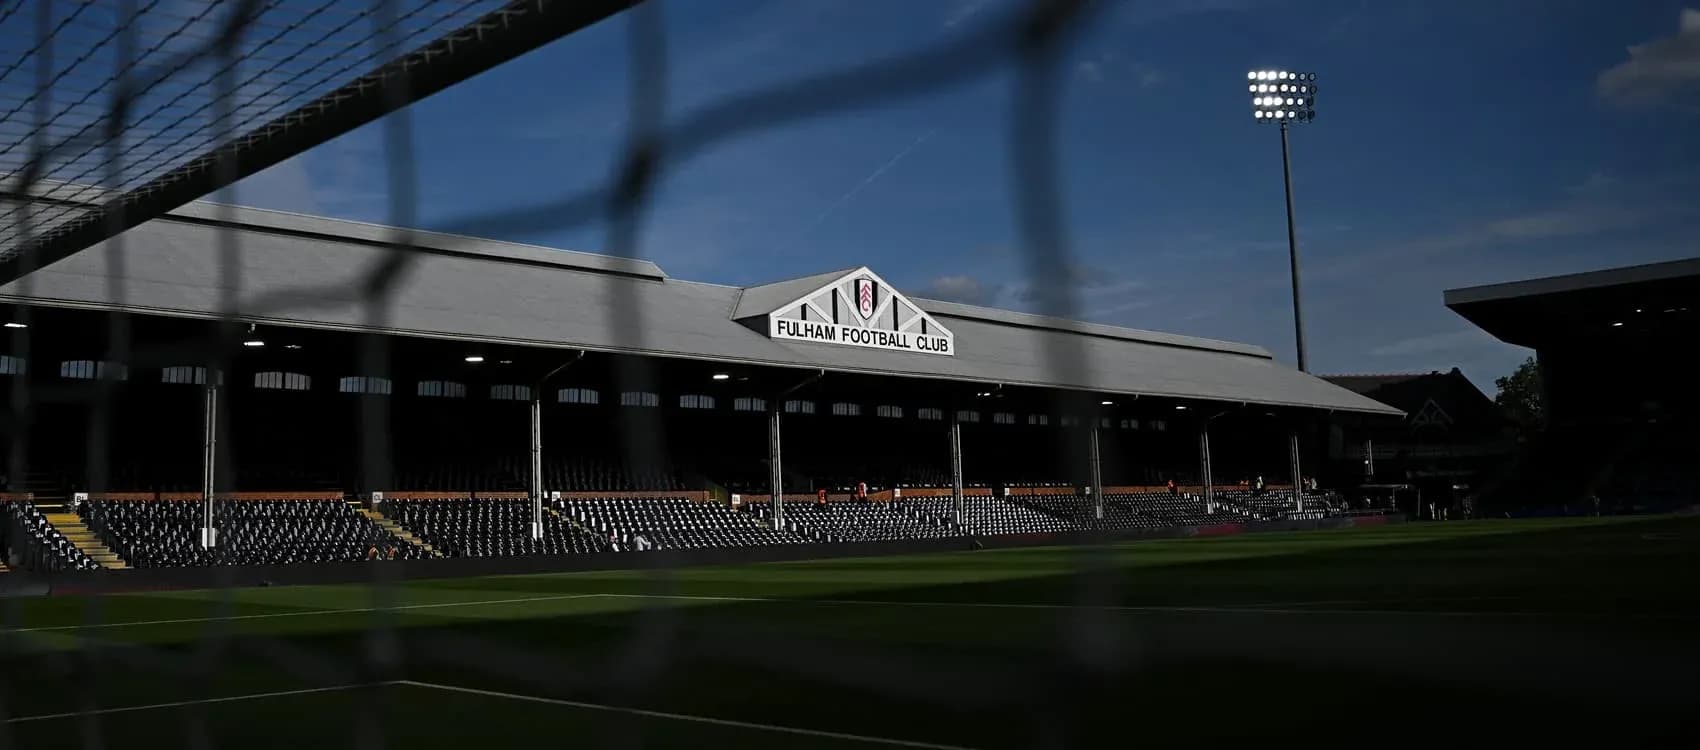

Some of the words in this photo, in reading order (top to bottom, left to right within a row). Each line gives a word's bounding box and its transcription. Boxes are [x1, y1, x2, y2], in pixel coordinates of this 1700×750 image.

[777, 320, 836, 341] FULHAM
[842, 327, 911, 348] FOOTBALL
[916, 335, 949, 352] CLUB
